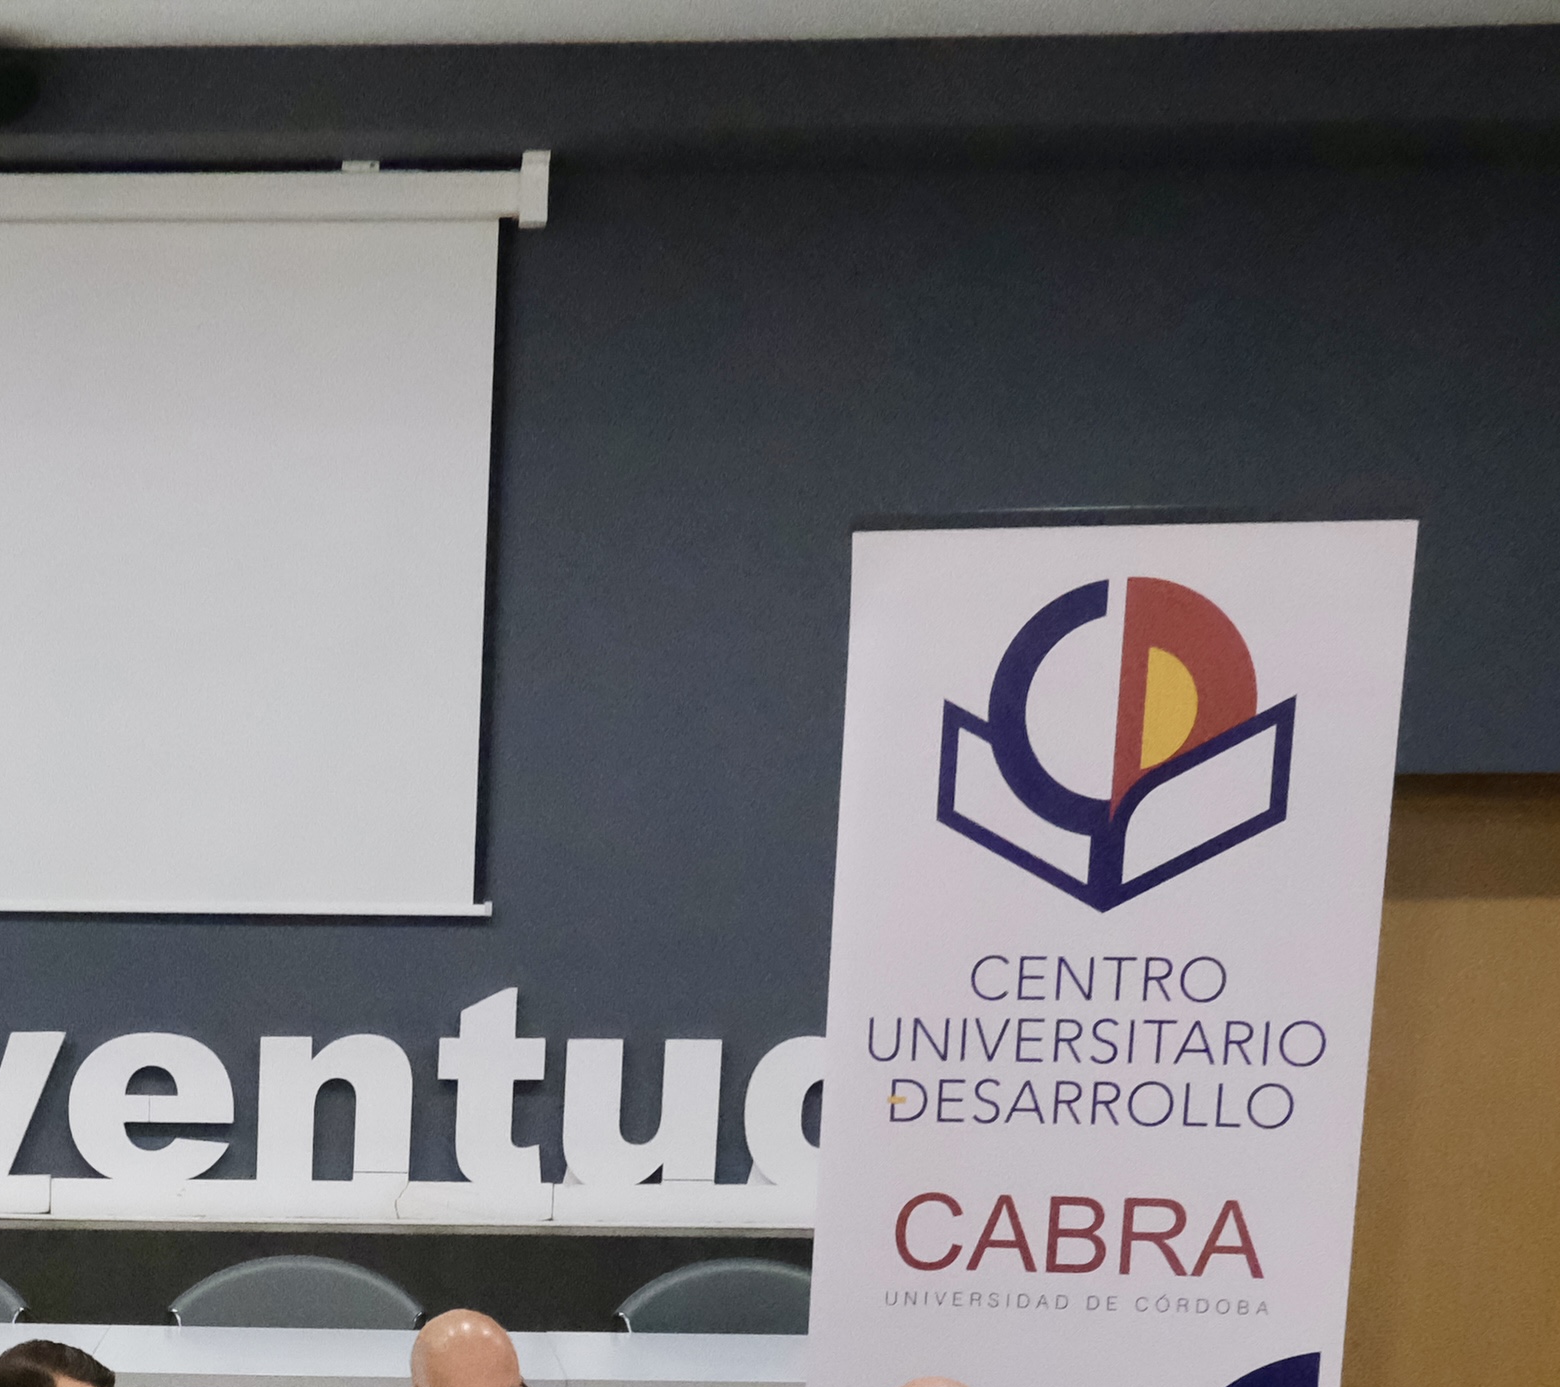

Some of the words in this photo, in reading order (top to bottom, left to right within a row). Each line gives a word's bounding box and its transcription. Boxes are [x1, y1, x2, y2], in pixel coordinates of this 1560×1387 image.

[970, 954, 1227, 1003] CENTRO
[867, 1016, 1327, 1067] UNIVERSITARIO
[888, 1078, 1295, 1129] DESARROLLO
[894, 1191, 1265, 1279] CABRA
[884, 1290, 1070, 1311] UNIVERSIDAD
[1085, 1295, 1119, 1313] DE
[1135, 1293, 1270, 1316] CÓRDOBA
